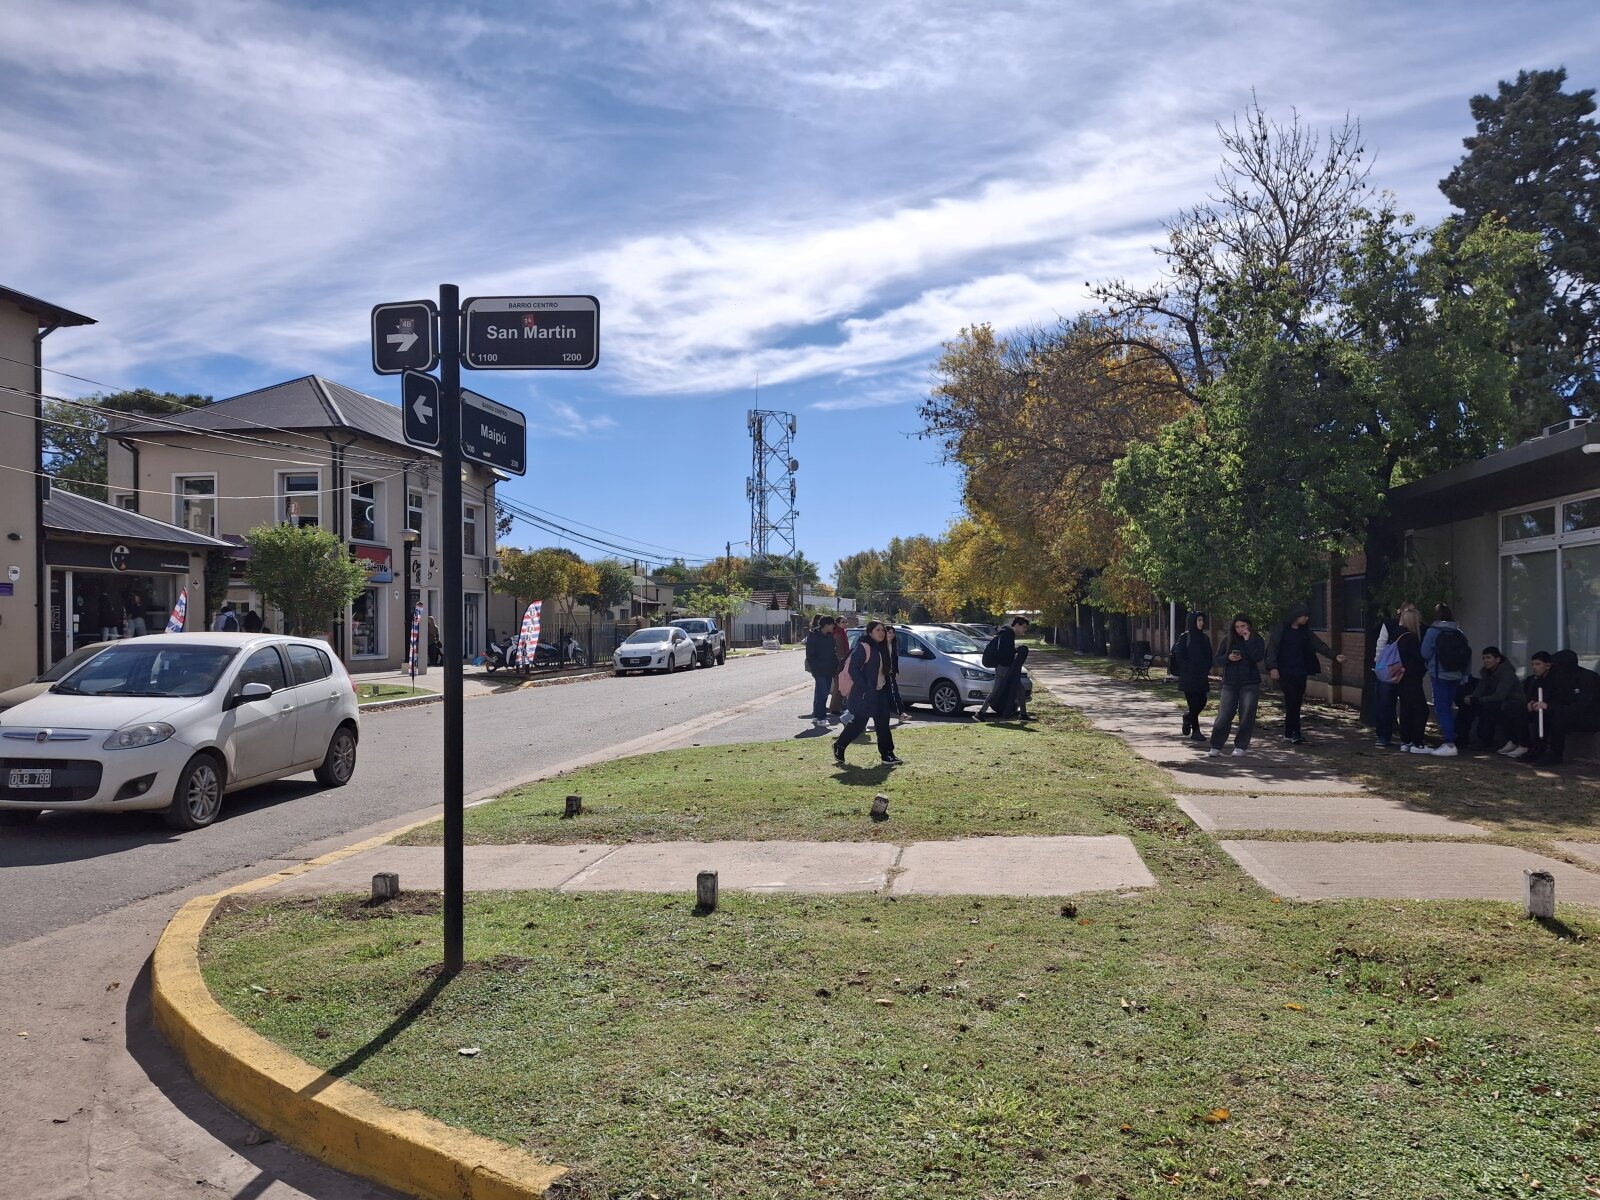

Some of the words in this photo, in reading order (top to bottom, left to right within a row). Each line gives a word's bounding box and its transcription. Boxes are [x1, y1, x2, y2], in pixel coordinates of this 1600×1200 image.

[486, 325, 518, 339] San
[523, 324, 576, 339] Martin
[477, 353, 498, 362] 1100
[561, 353, 582, 361] 1200
[480, 423, 507, 445] Maipú
